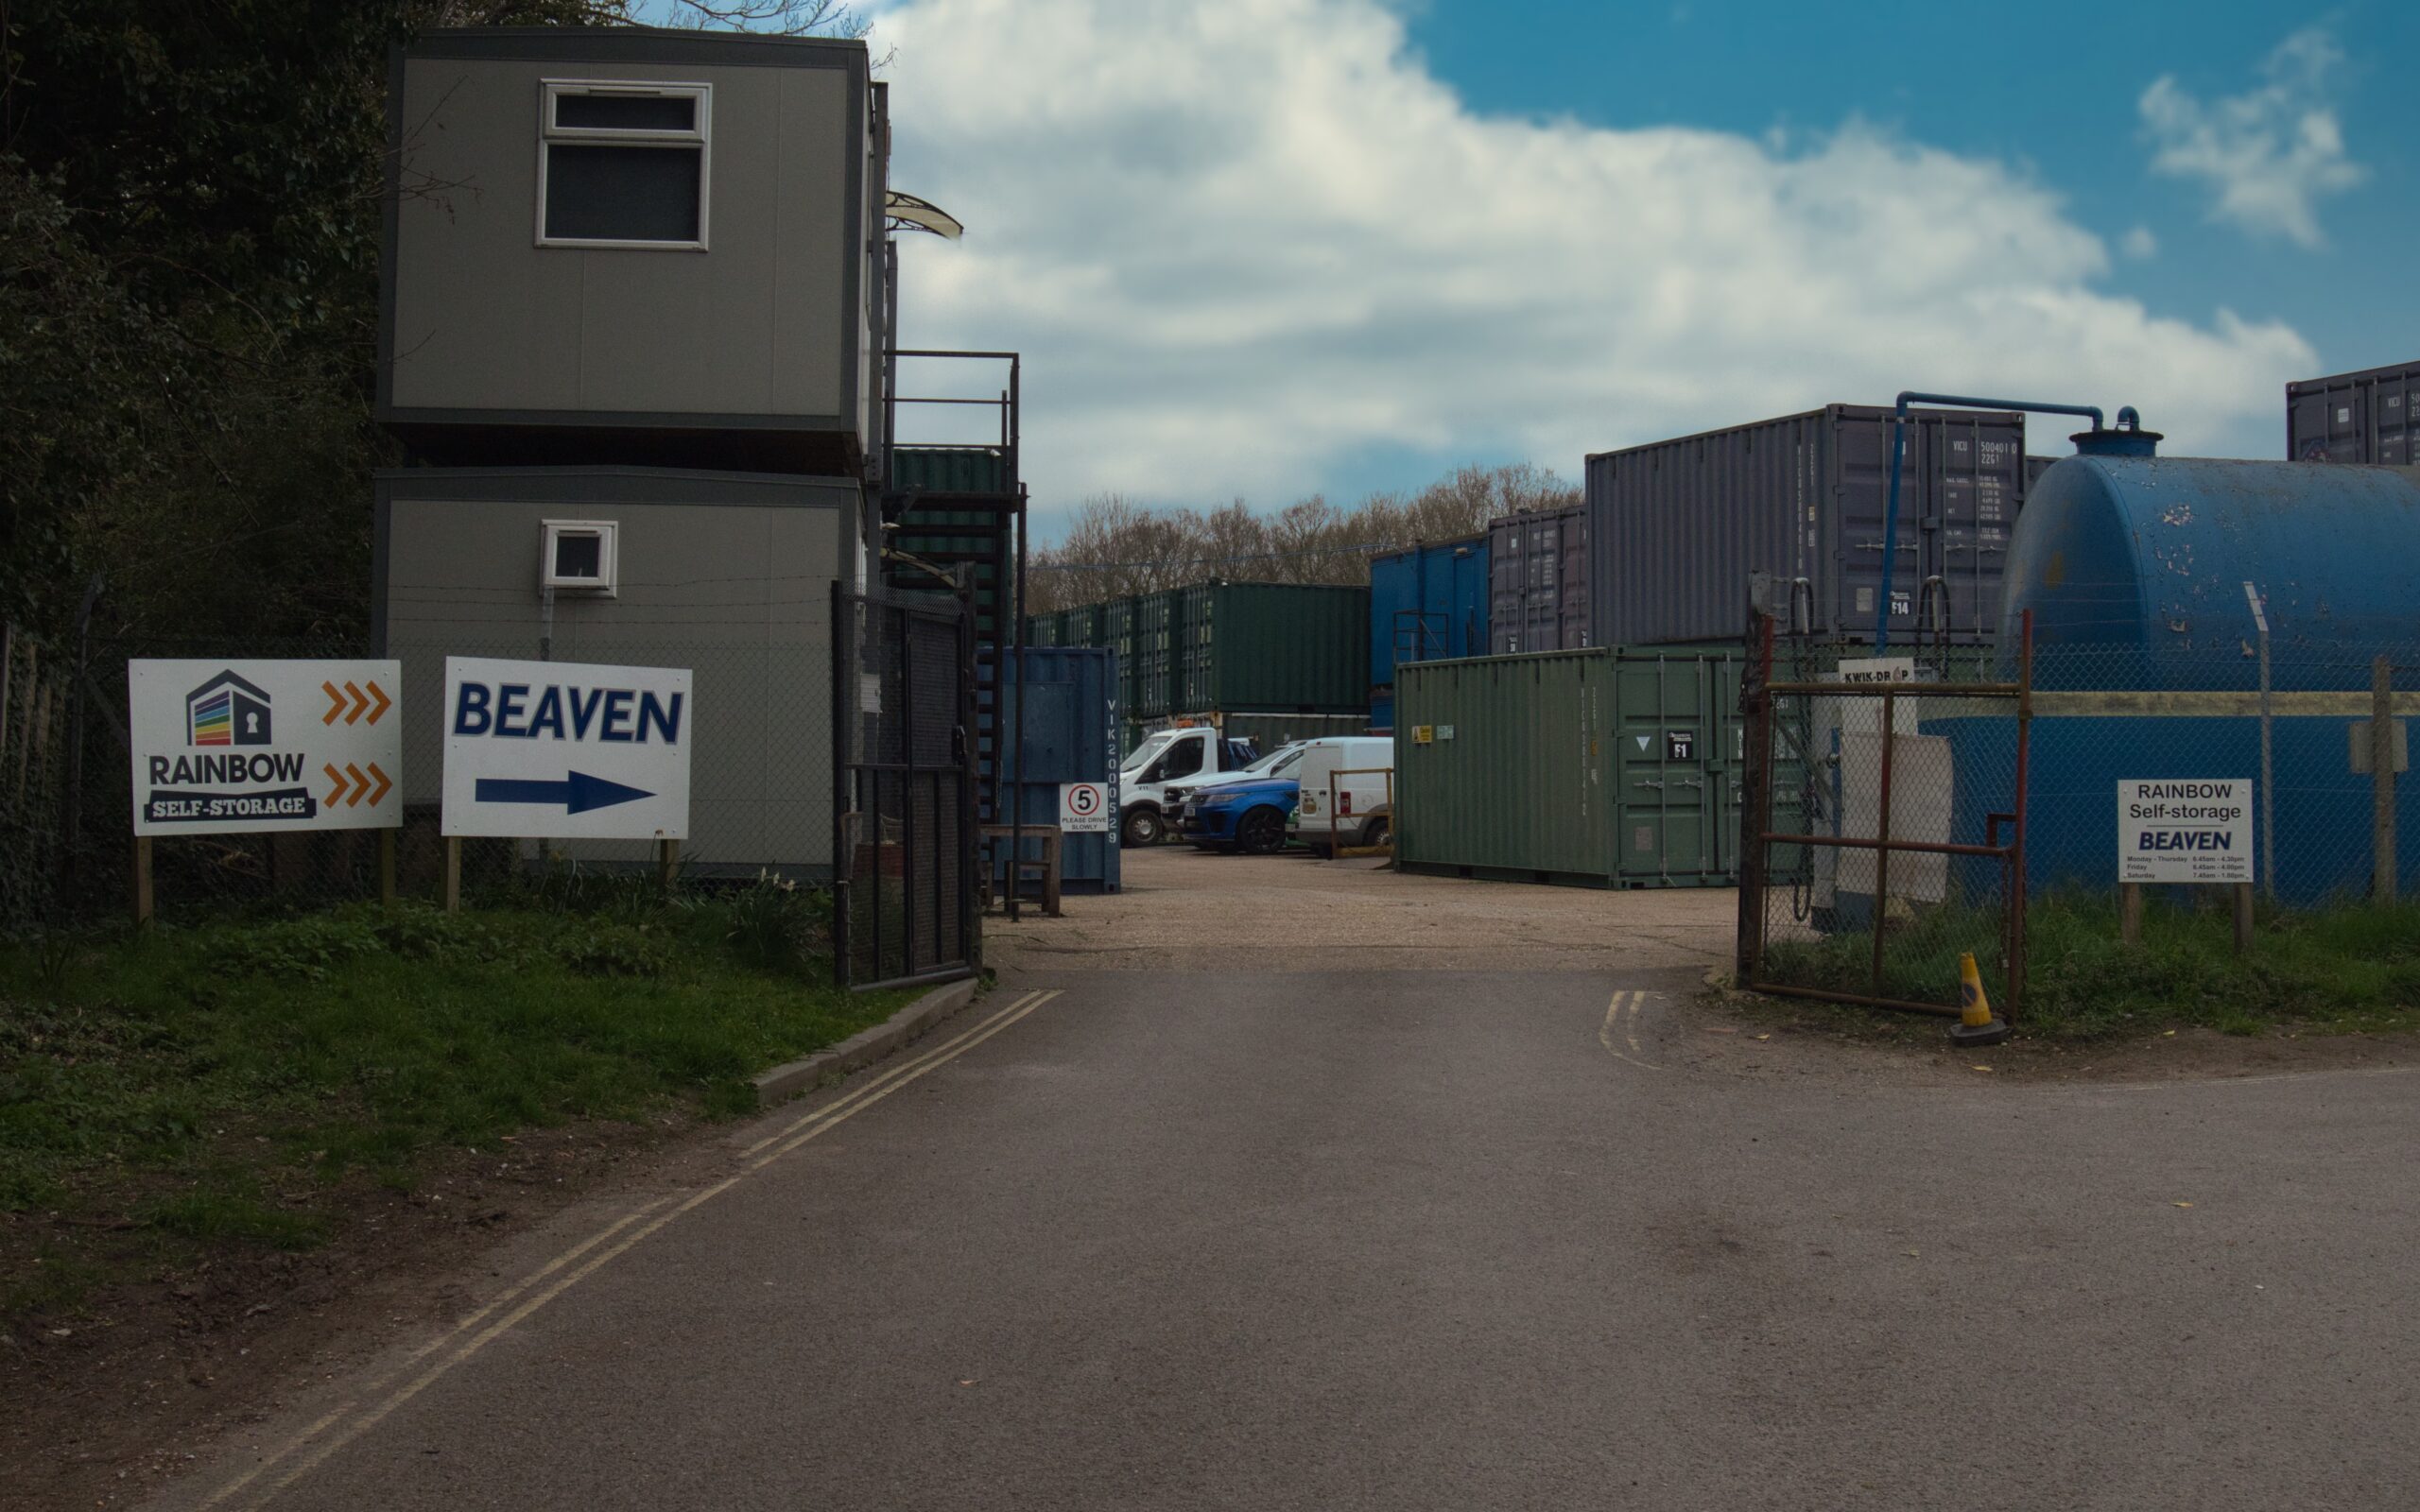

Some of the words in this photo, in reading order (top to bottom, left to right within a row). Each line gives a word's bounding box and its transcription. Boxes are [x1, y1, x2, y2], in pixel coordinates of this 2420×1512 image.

[1953, 440, 1968, 453] VICU
[1980, 441, 2008, 454] 500401
[2012, 442, 2017, 455] 0
[1891, 601, 1909, 615] F14
[453, 681, 684, 745] BEAVEN
[1674, 743, 1687, 758] F1
[148, 752, 305, 785] RAINBOW
[1078, 789, 1091, 811] 5
[2138, 783, 2233, 799] RAINBOW
[151, 797, 306, 818] SELF-STORAGE
[2130, 804, 2241, 822] Self-storage
[2139, 832, 2232, 850] BEAVEN
